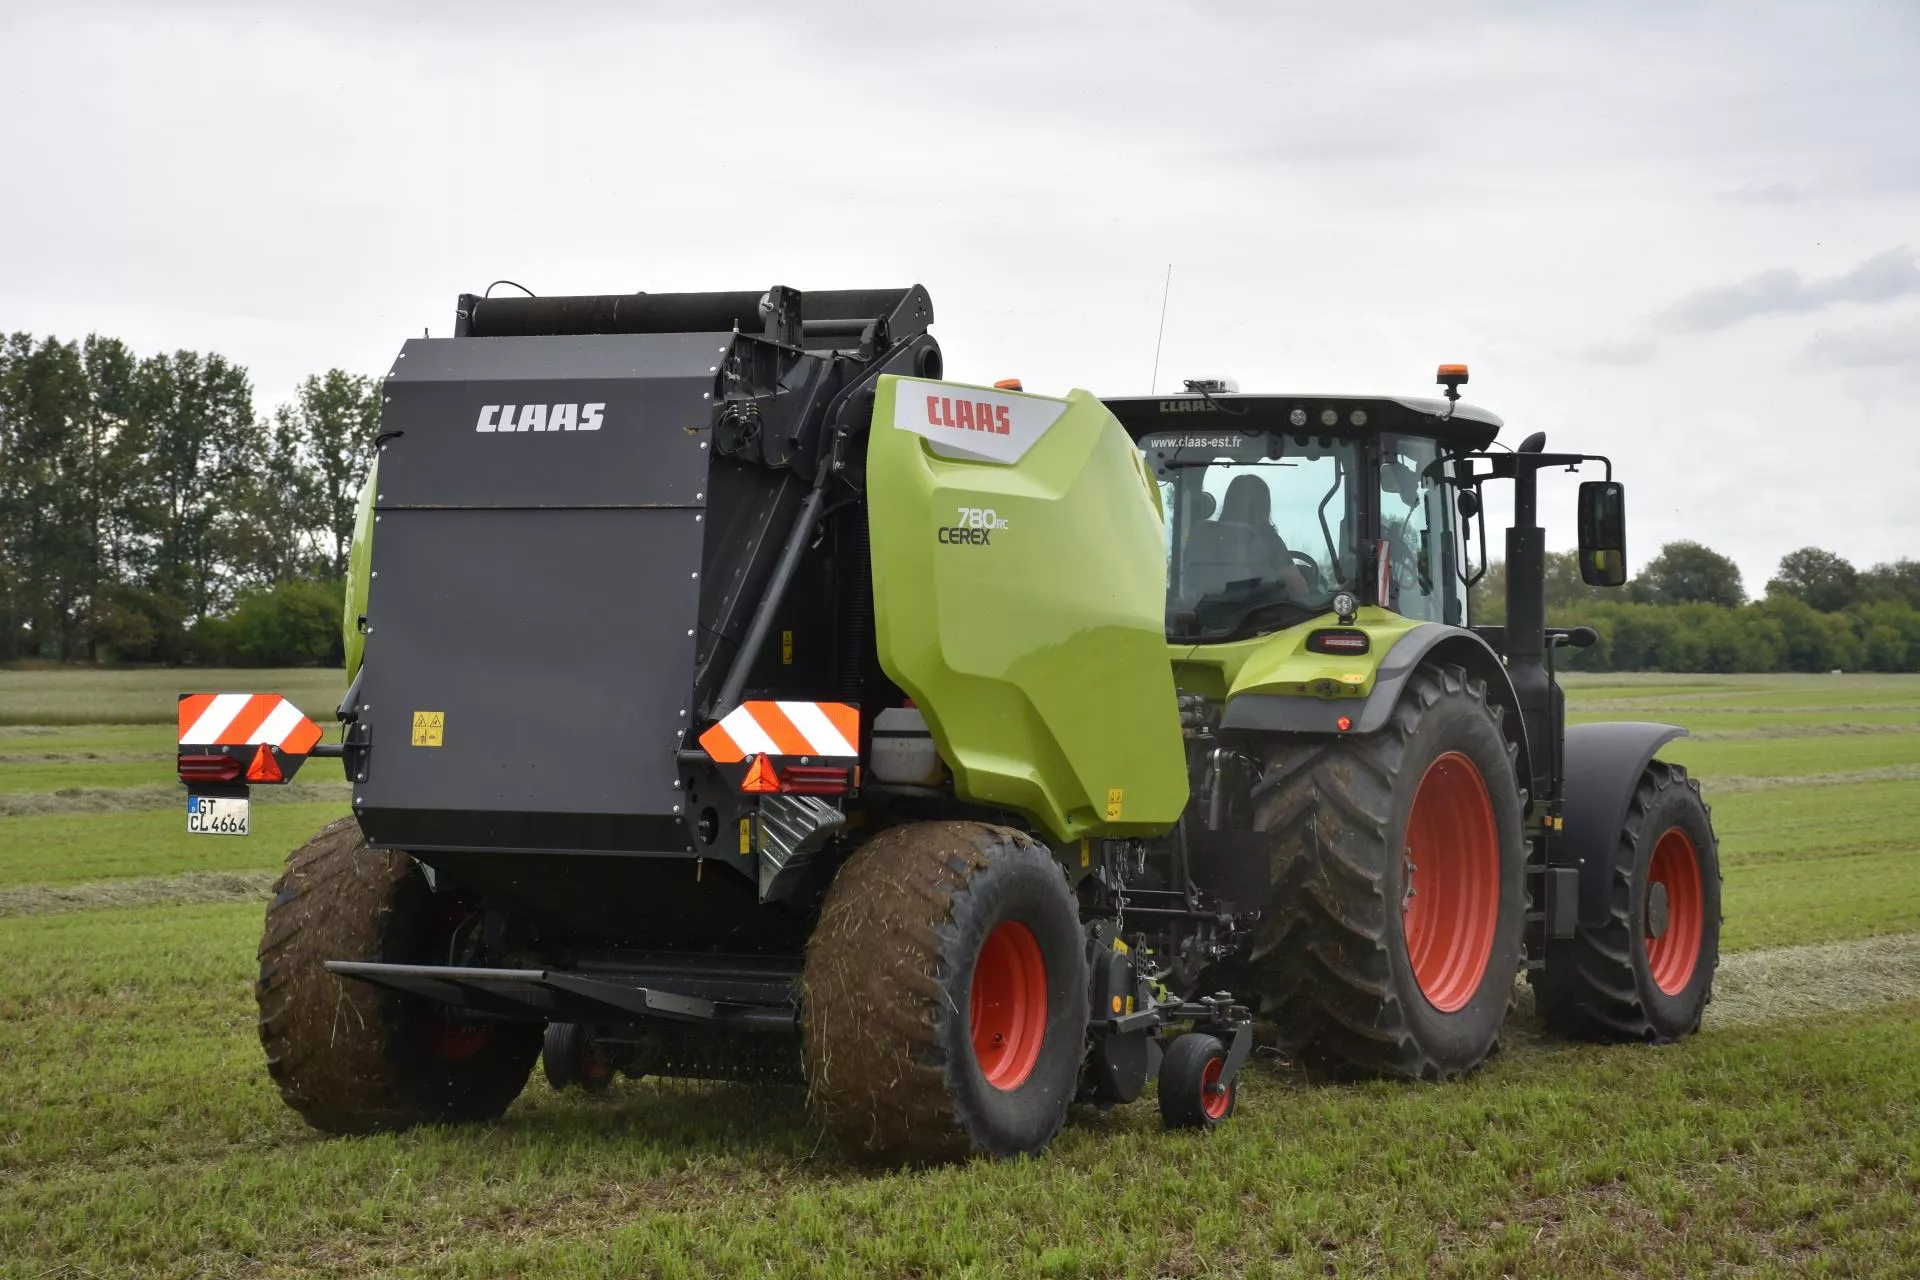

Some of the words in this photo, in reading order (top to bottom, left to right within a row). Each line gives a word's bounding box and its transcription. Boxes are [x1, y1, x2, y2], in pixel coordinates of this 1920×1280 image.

[926, 396, 1010, 435] CLAAS
[1159, 401, 1218, 413] CLAAS
[475, 402, 606, 432] CLAAS
[1150, 435, 1243, 449] www.claas-est.fr
[938, 527, 991, 545] CEREX
[198, 799, 216, 815] GT
[190, 813, 208, 831] CL
[211, 817, 246, 833] 4664
